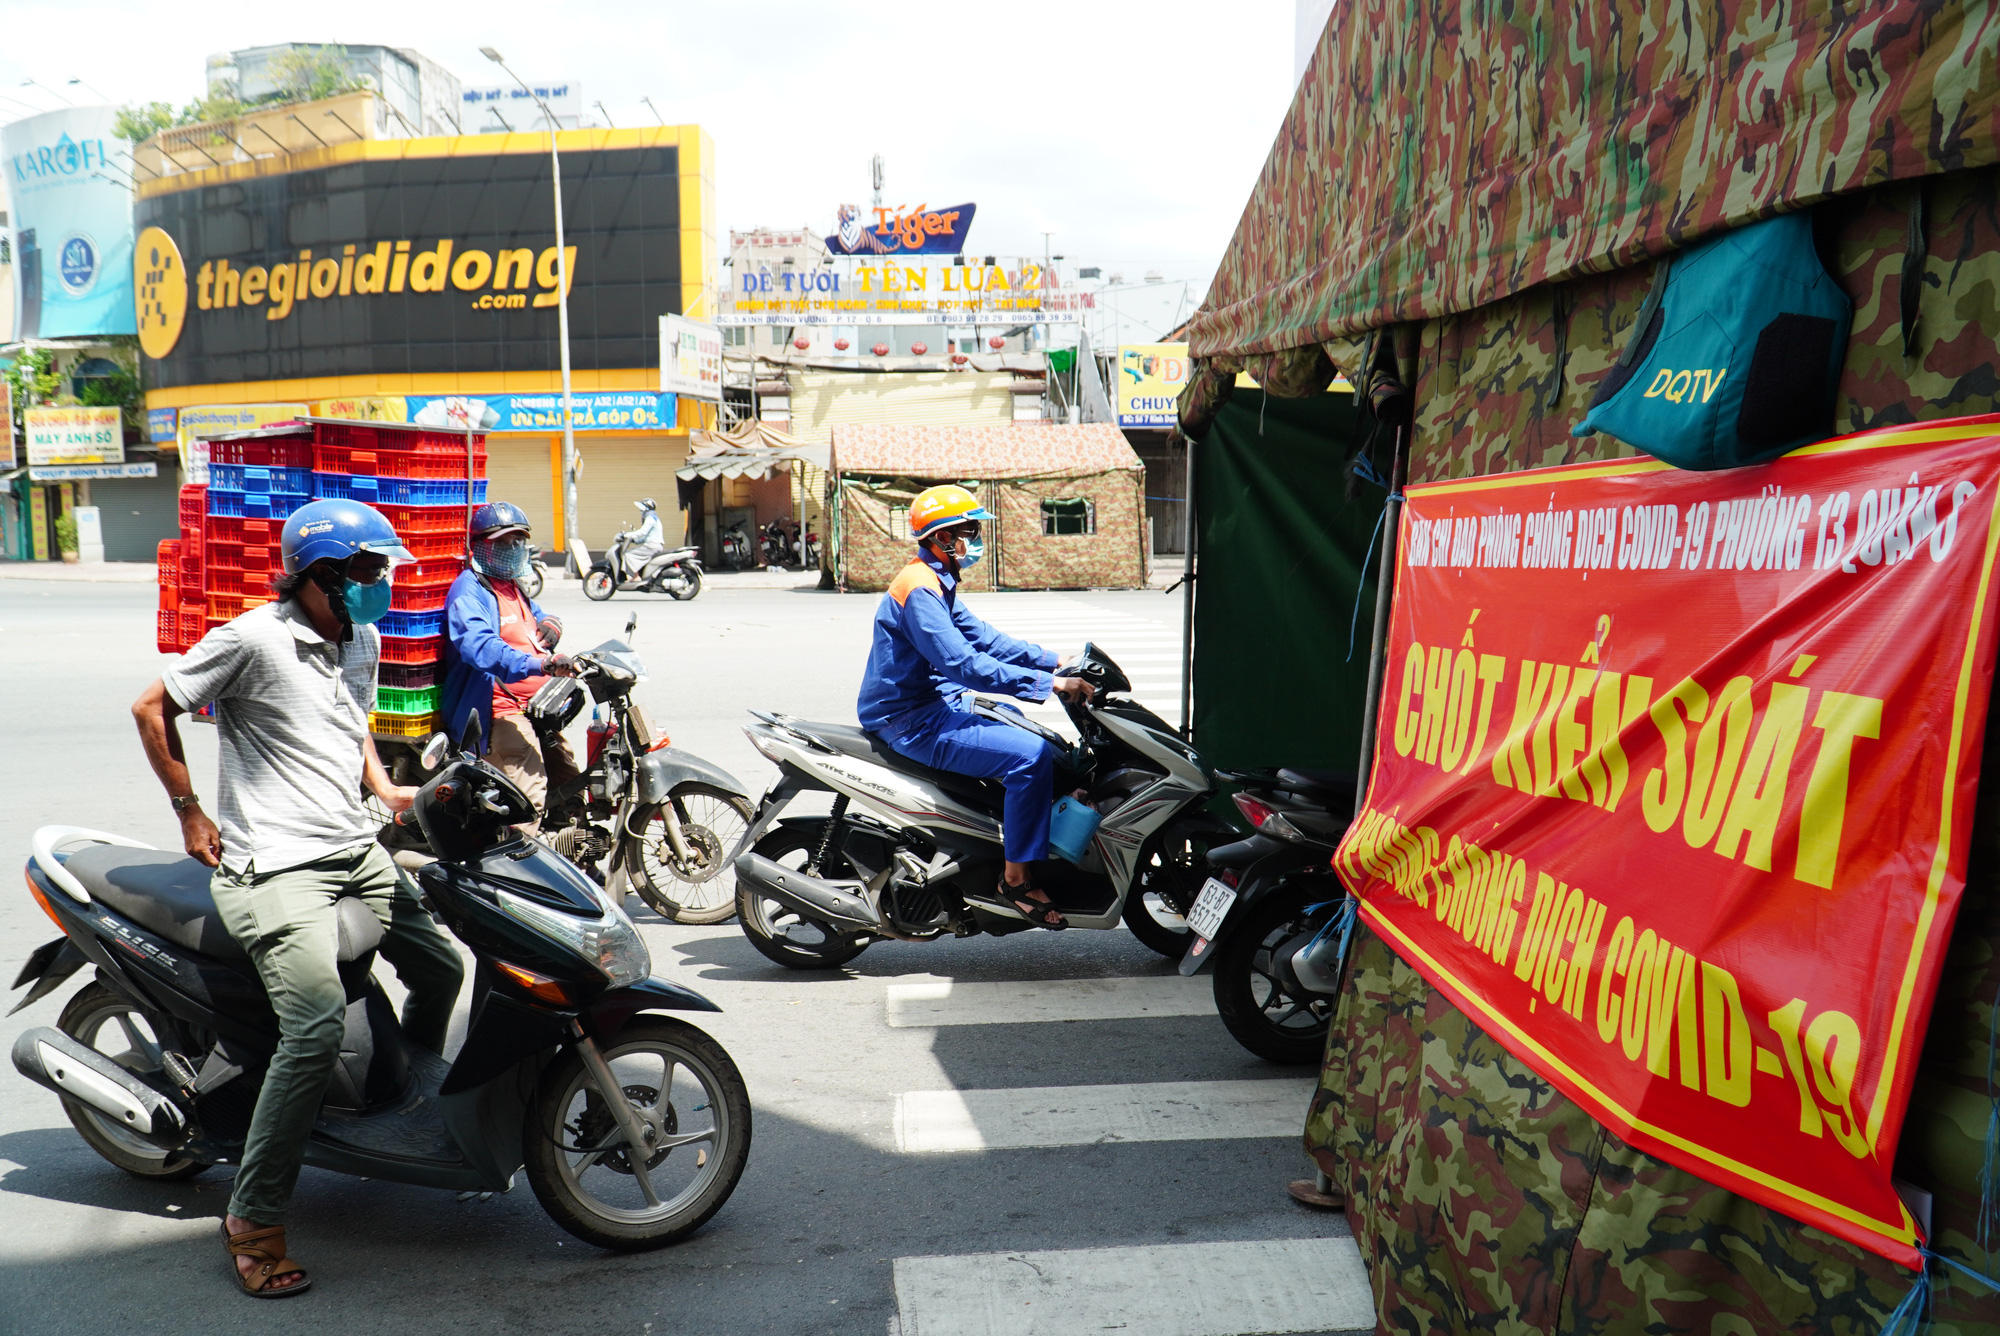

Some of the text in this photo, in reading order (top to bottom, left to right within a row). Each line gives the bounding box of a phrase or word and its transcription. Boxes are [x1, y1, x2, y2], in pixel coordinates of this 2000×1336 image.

[13, 136, 105, 181] KAROFI
[872, 203, 960, 249] Tiger
[196, 239, 578, 320] thegioididong
[742, 266, 773, 292] DÊ
[782, 268, 840, 292] TƯƠI
[856, 260, 928, 292] TÊN
[941, 257, 1011, 292] LỬA
[1022, 265, 1040, 292] 2
[472, 293, 526, 309] .com
[510, 397, 556, 408] SAMSUNG
[1643, 368, 1727, 404] DQTV
[598, 408, 630, 425] GÓP
[632, 407, 658, 425] 0%
[1407, 519, 1432, 567] BAN
[1431, 505, 1454, 568] CHỈ
[1450, 516, 1478, 577] ĐẠO
[1476, 506, 1522, 569] PHÒNG
[1522, 491, 1575, 570] CHỐNG
[1573, 507, 1617, 581] DỊCH
[1617, 501, 1710, 571] COVID-19
[1706, 484, 1812, 571] PHƯỜNG
[1394, 608, 1506, 776] CHỐT
[1642, 654, 1884, 891] SOÁT
[847, 773, 898, 797] BLADE
[101, 916, 178, 967] CLICK
[1514, 871, 1608, 1022] DỊCH
[1596, 915, 1870, 1160] COVID-19
